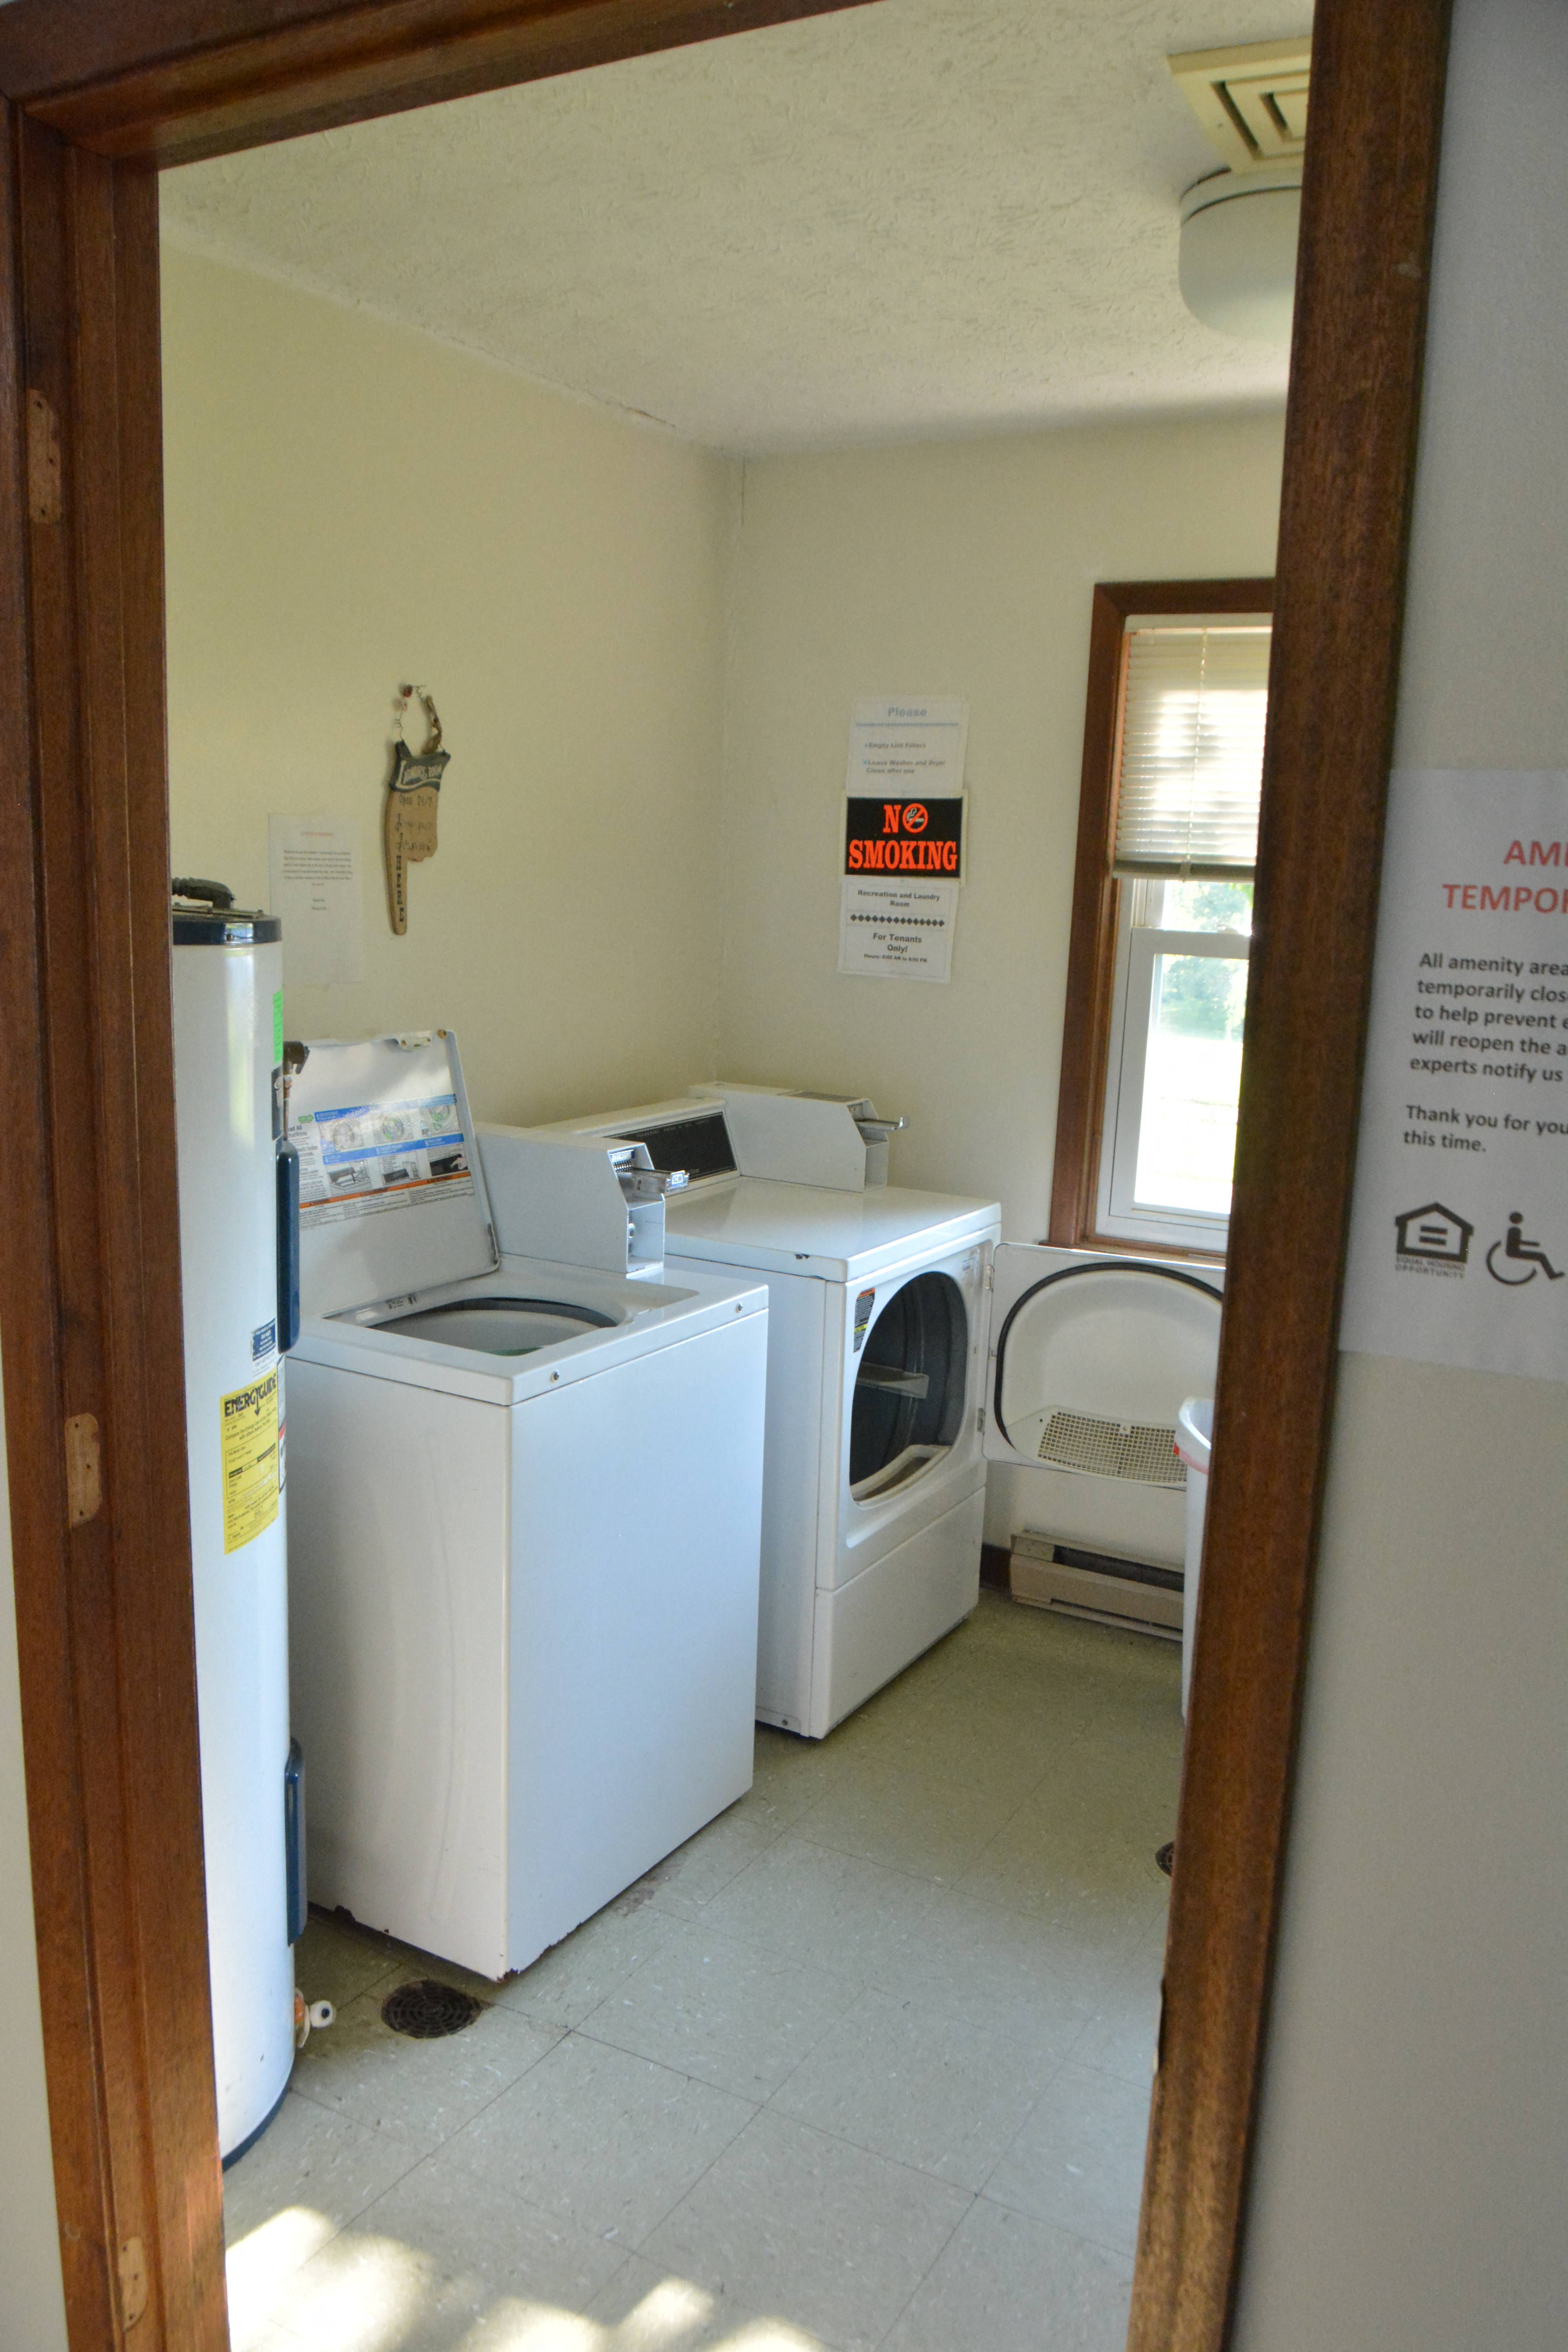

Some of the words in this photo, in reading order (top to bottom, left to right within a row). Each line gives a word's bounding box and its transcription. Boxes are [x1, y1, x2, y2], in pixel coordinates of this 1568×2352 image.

[887, 707, 927, 717] Please
[848, 839, 958, 871] SMOKING
[1503, 840, 1568, 867] AM
[858, 889, 897, 898] Recreation
[1442, 884, 1568, 914] TEMPO
[887, 944, 908, 954] Only!
[889, 934, 922, 943] Tenants
[1419, 952, 1443, 968] All
[1448, 954, 1523, 976] amenity
[1417, 979, 1524, 1003] temporarily
[1531, 985, 1568, 1003] clos
[1416, 1005, 1434, 1020] to
[1439, 1005, 1478, 1025] help
[1484, 1012, 1556, 1030] prevent
[1413, 1031, 1444, 1046] will
[1450, 1036, 1514, 1053] reopen
[1520, 1037, 1551, 1055] the
[1410, 1058, 1477, 1076] experts
[1483, 1062, 1537, 1084] notify
[1543, 1069, 1563, 1082] us
[1406, 1105, 1460, 1124] Thank
[1465, 1111, 1498, 1130] you
[1504, 1114, 1530, 1132] for
[1403, 1131, 1435, 1148] this
[1441, 1135, 1486, 1152] time.
